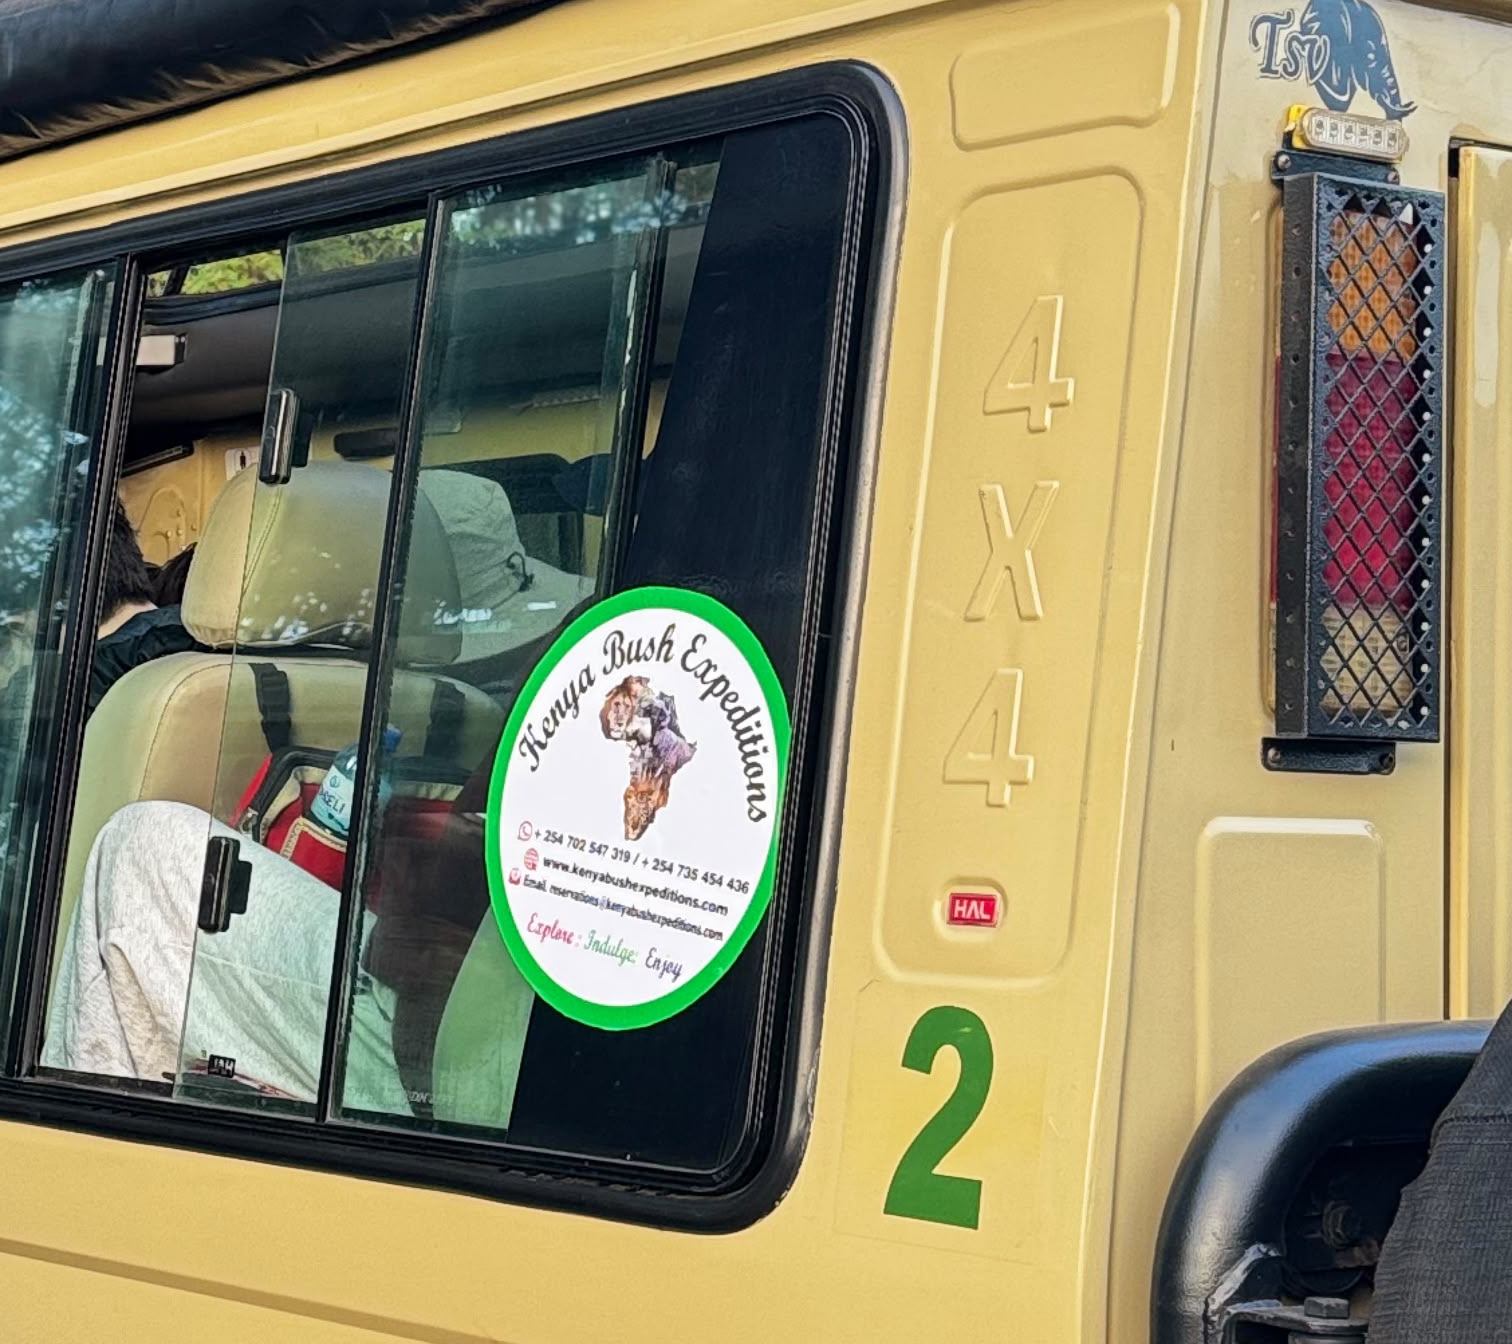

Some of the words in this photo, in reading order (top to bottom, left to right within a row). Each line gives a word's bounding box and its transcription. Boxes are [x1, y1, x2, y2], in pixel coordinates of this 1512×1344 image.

[519, 663, 596, 772] Kenya
[602, 623, 676, 675] Bush
[680, 633, 770, 823] Expeditions
[543, 829, 563, 845] 254
[567, 835, 587, 852] 702
[588, 841, 609, 857] 547
[611, 847, 631, 863] 319
[652, 858, 674, 874] 254
[677, 863, 699, 881] 735
[701, 871, 724, 888] 454
[726, 877, 750, 894] 436
[543, 856, 729, 917] www.kenyabushexpeditions.com
[954, 899, 991, 920] HAL
[645, 946, 683, 984] Enjoy
[883, 1005, 995, 1231] 2
